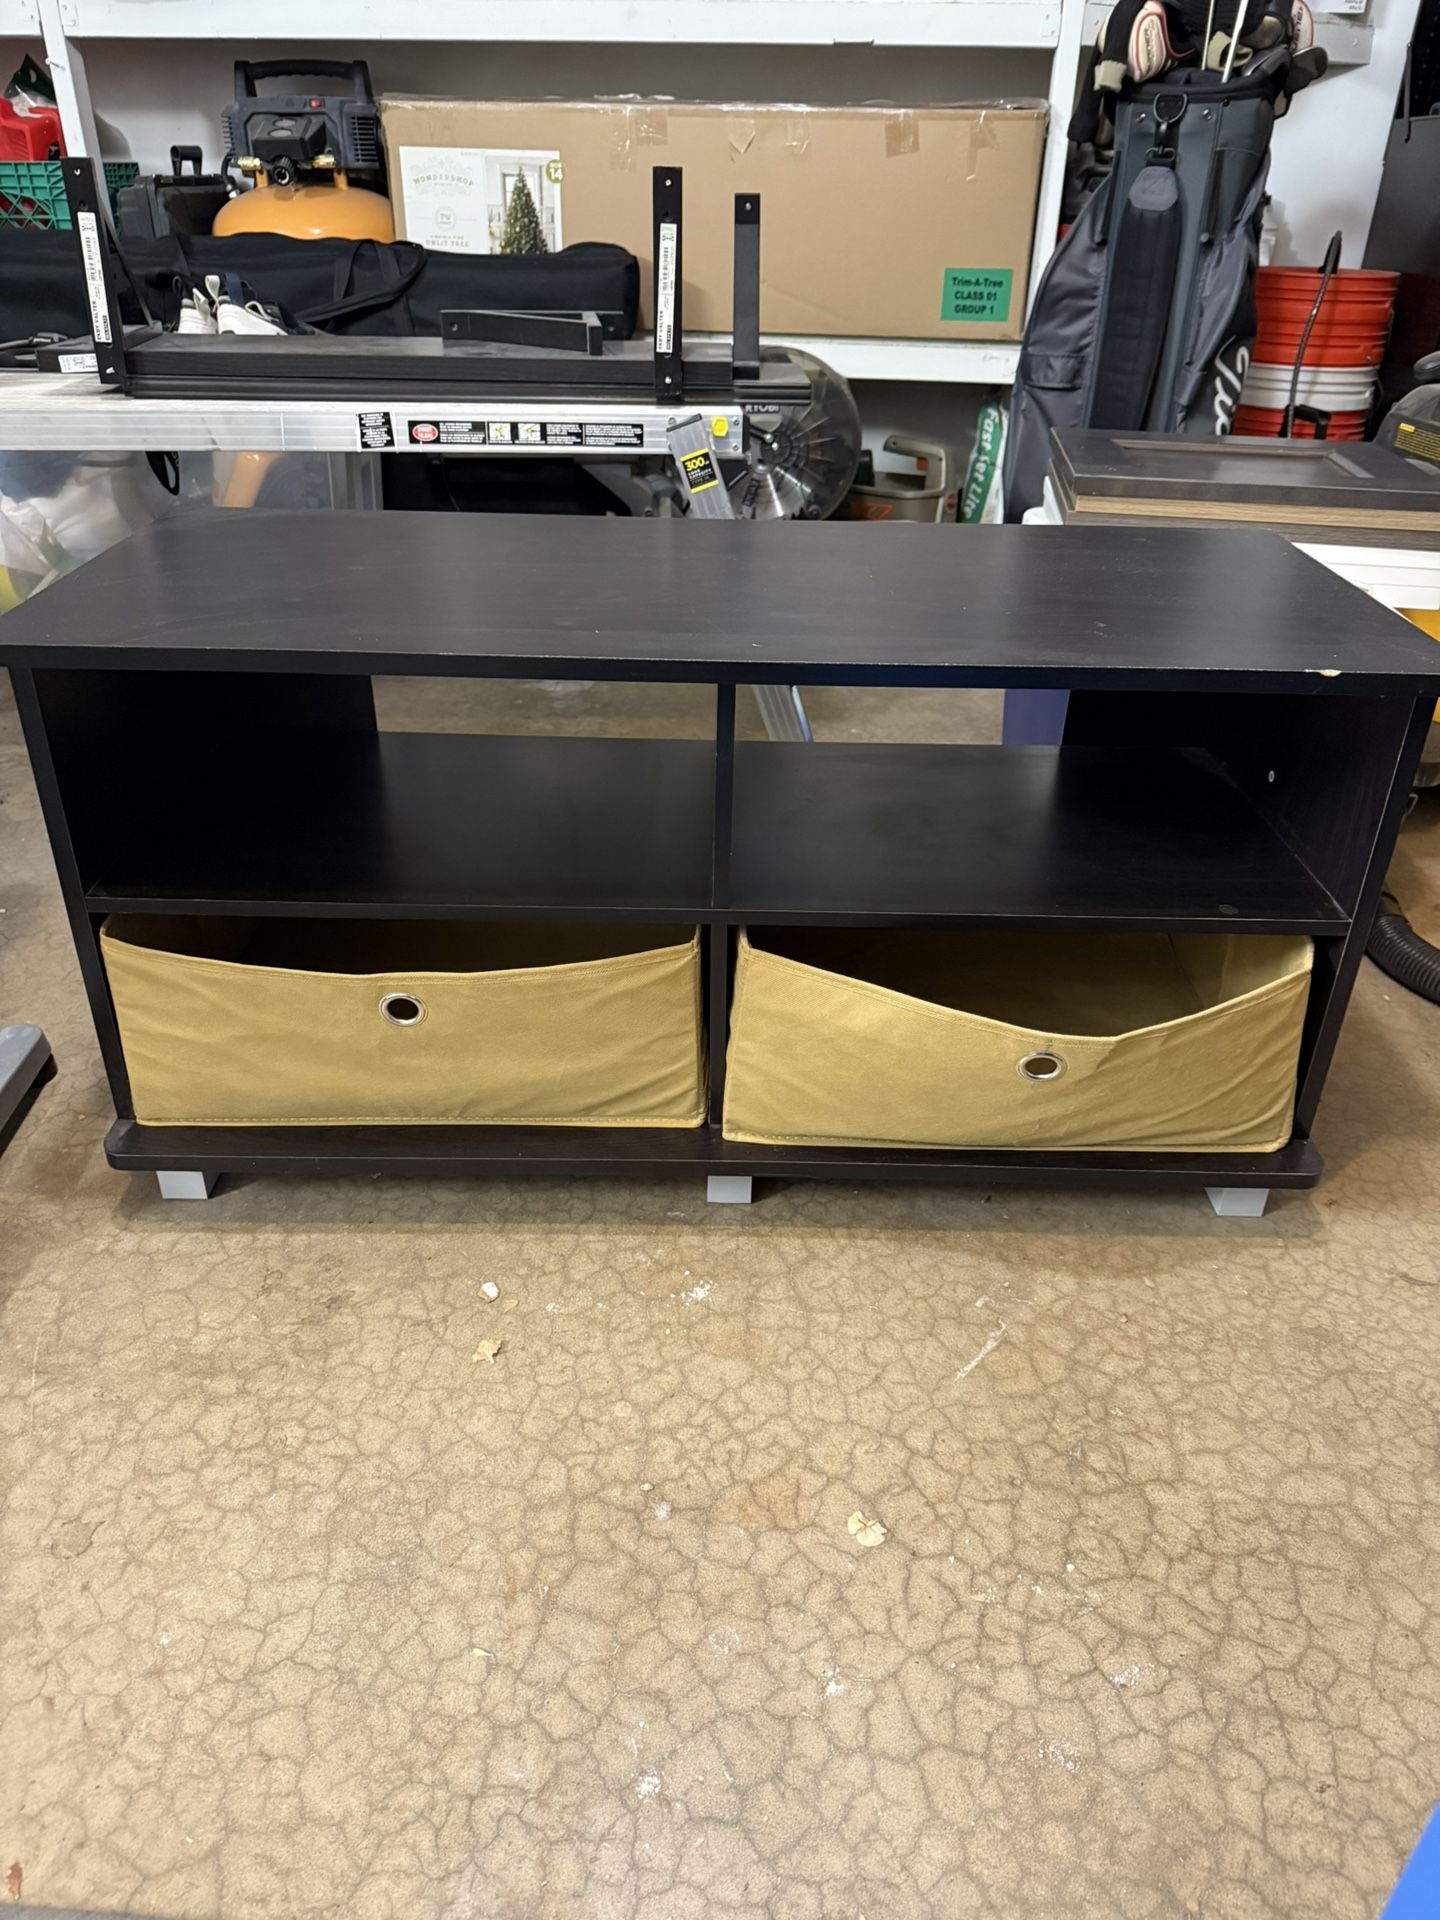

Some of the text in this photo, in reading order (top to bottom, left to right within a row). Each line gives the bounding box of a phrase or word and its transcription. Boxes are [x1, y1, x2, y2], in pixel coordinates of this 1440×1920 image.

[413, 174, 475, 186] WONDERSHOP
[451, 240, 470, 248] TREE
[951, 277, 1004, 288] Trim-A-Tree
[954, 291, 997, 301] CLASS 01
[954, 304, 994, 315] GROUP 1
[981, 407, 999, 451] Fast
[684, 456, 705, 472] 300
[974, 454, 990, 482] Set
